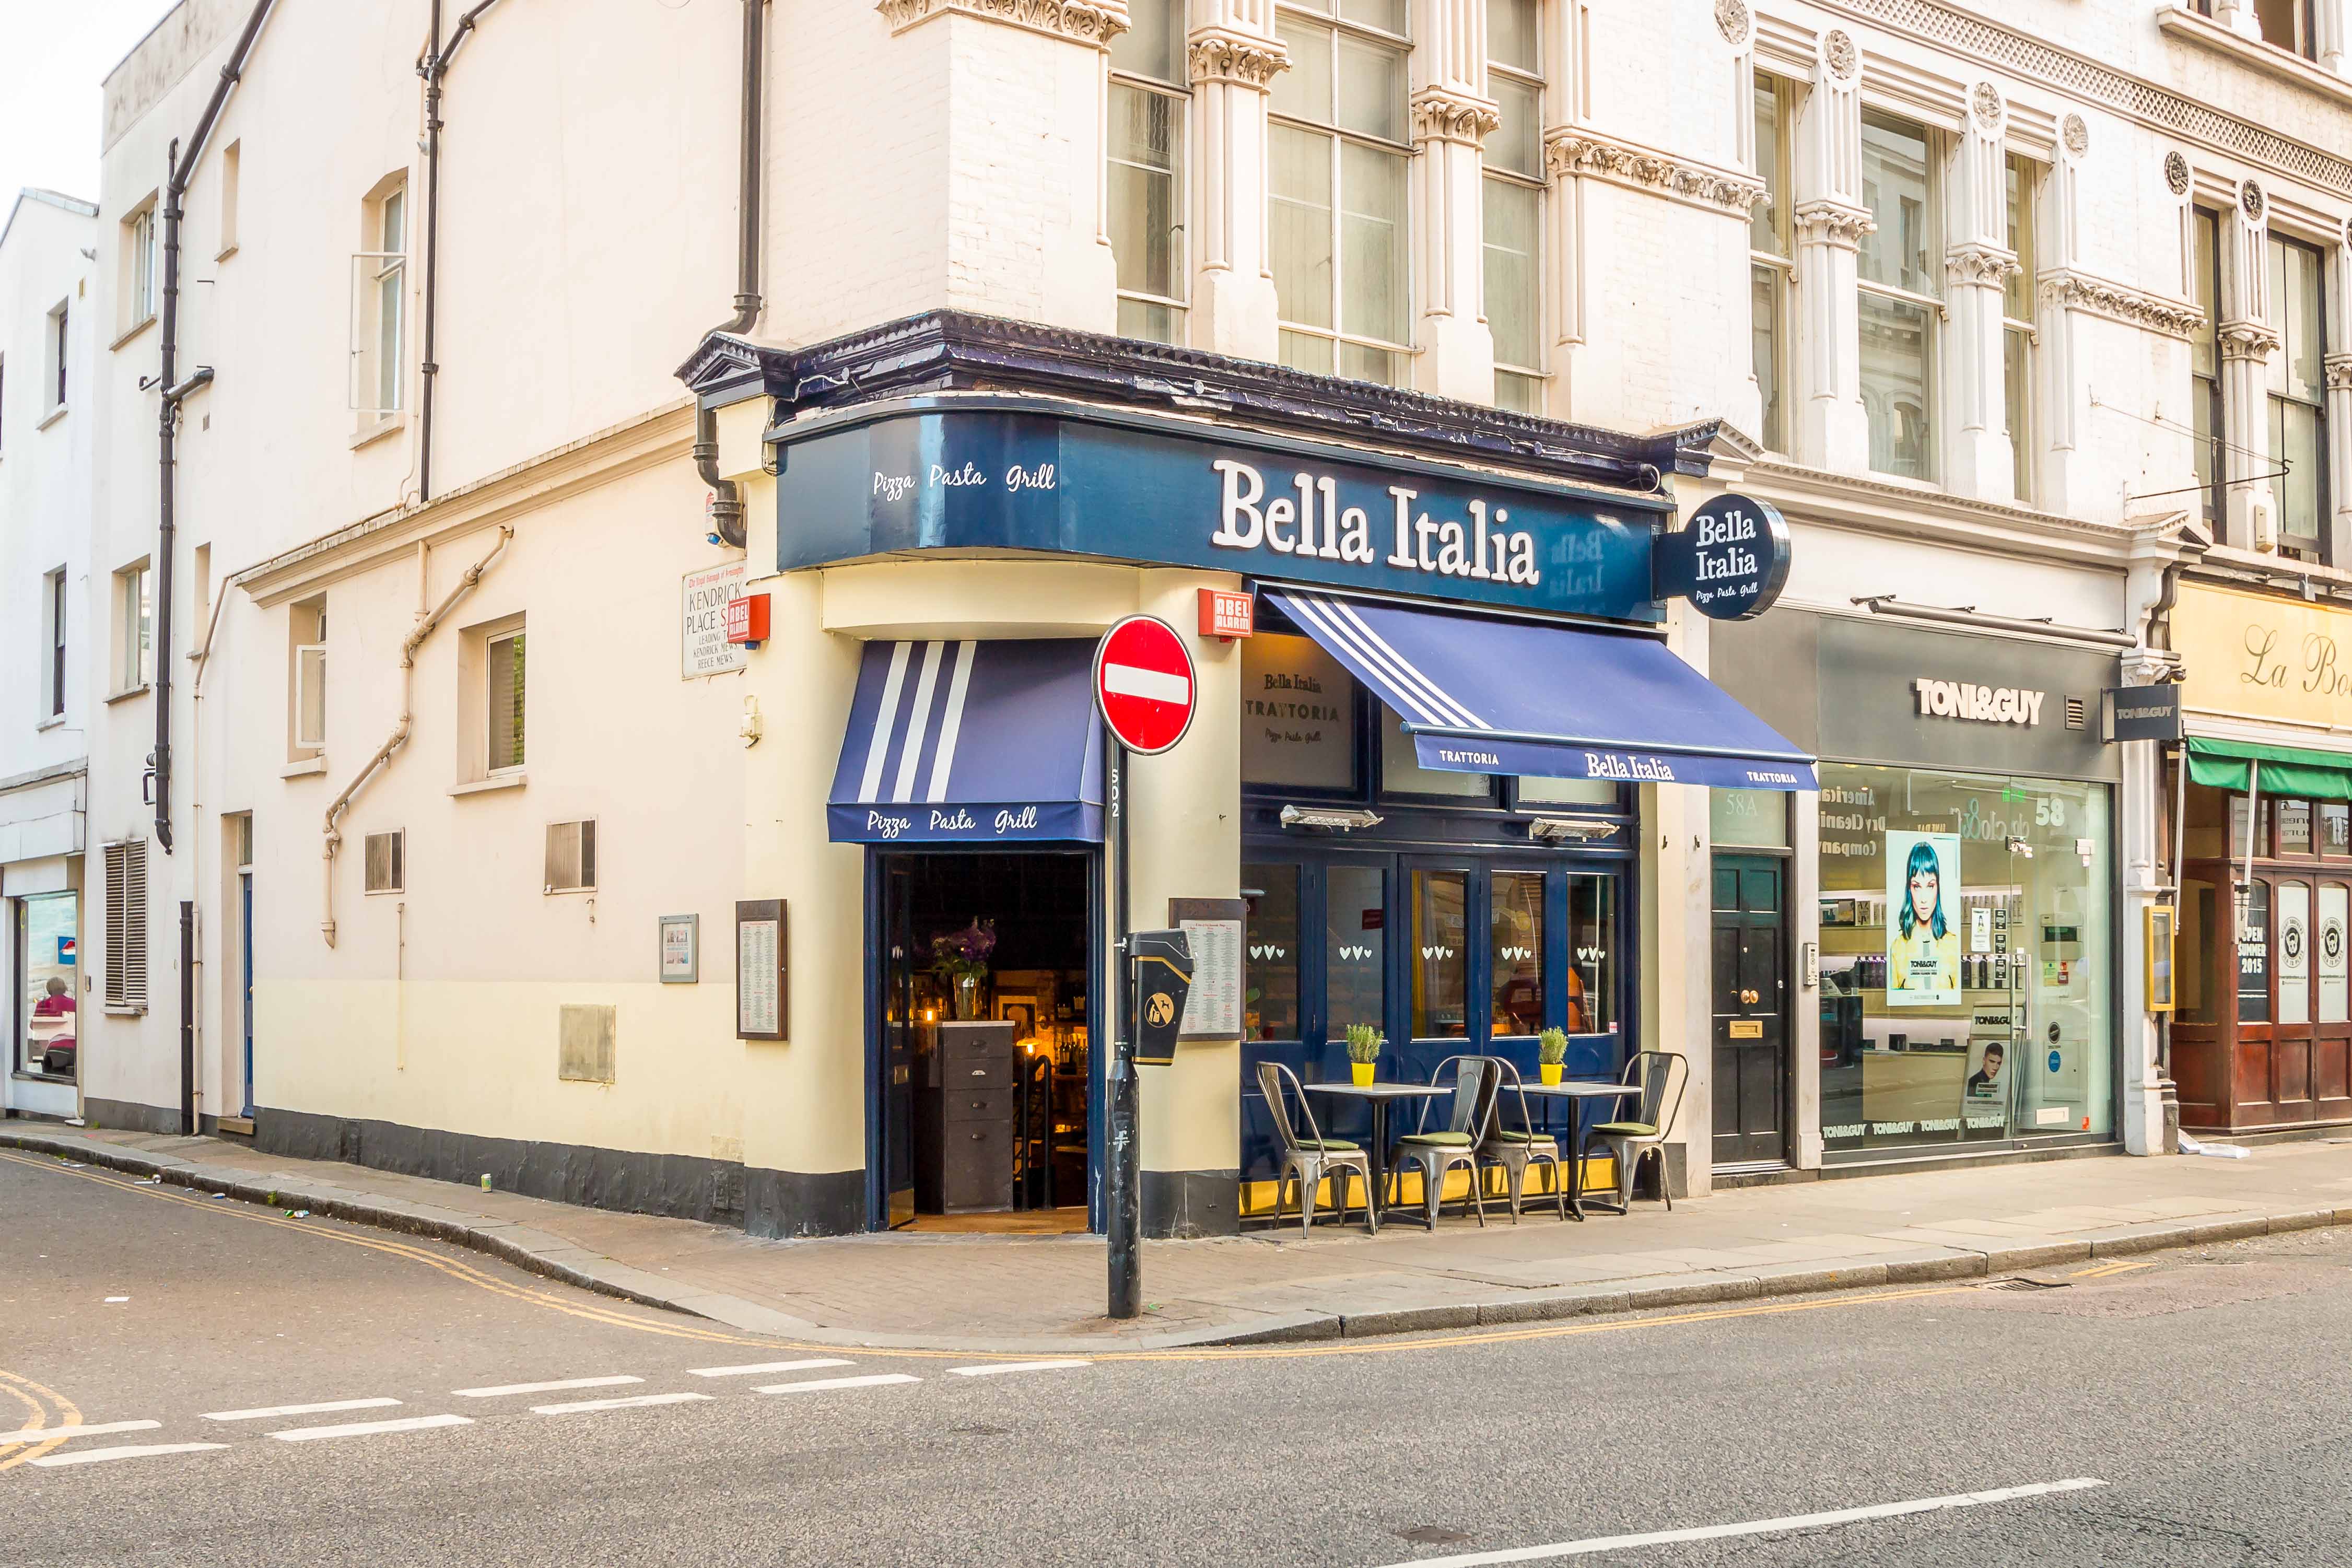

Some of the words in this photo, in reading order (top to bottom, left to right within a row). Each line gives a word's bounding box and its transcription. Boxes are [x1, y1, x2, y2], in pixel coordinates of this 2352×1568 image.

[873, 472, 916, 502] Pizza
[930, 461, 987, 487] Pasta
[1006, 463, 1056, 492] Grill
[1212, 459, 1374, 564] Bella
[1387, 485, 1540, 586] Italia
[1696, 510, 1757, 547] Bella
[1695, 547, 1758, 581] Italia
[689, 581, 742, 612] KENDRICK
[1696, 590, 1714, 604] Pizza
[1717, 586, 1737, 598] Pasta
[1740, 581, 1758, 597] Grill
[730, 604, 748, 622] ABEL
[1216, 598, 1248, 617] ABEL
[1216, 615, 1248, 630] ALARM
[699, 631, 720, 645] LEADING
[694, 643, 719, 659] KENDRICK
[2240, 624, 2289, 688] La
[2301, 633, 2352, 698] Bo
[698, 656, 714, 669] REECE
[1263, 673, 1292, 690] Bella
[1293, 674, 1322, 694] Italia
[1245, 700, 1340, 722] TRATTORIA
[1916, 678, 2045, 726] TONI&GUY
[2117, 706, 2173, 719] TONI&GUY
[1440, 750, 1499, 765] TRATTORIA
[1585, 753, 1630, 778] Bella
[1628, 756, 1675, 781] Italia
[1747, 771, 1797, 784] TRATTORIA
[1726, 793, 1758, 816] 58A
[2035, 798, 2065, 826] 58
[867, 810, 911, 839] Pizza
[929, 809, 976, 830] Pasta
[994, 806, 1037, 834] Grill
[2238, 943, 2266, 956] SUMMER
[2242, 958, 2262, 974] 2015
[1822, 1124, 1867, 1138] TONI&GUY
[1872, 1121, 1915, 1135] TONI&GUY
[1920, 1118, 1961, 1132] TONI&GUY
[1966, 1116, 2006, 1129] TONI&GUY
